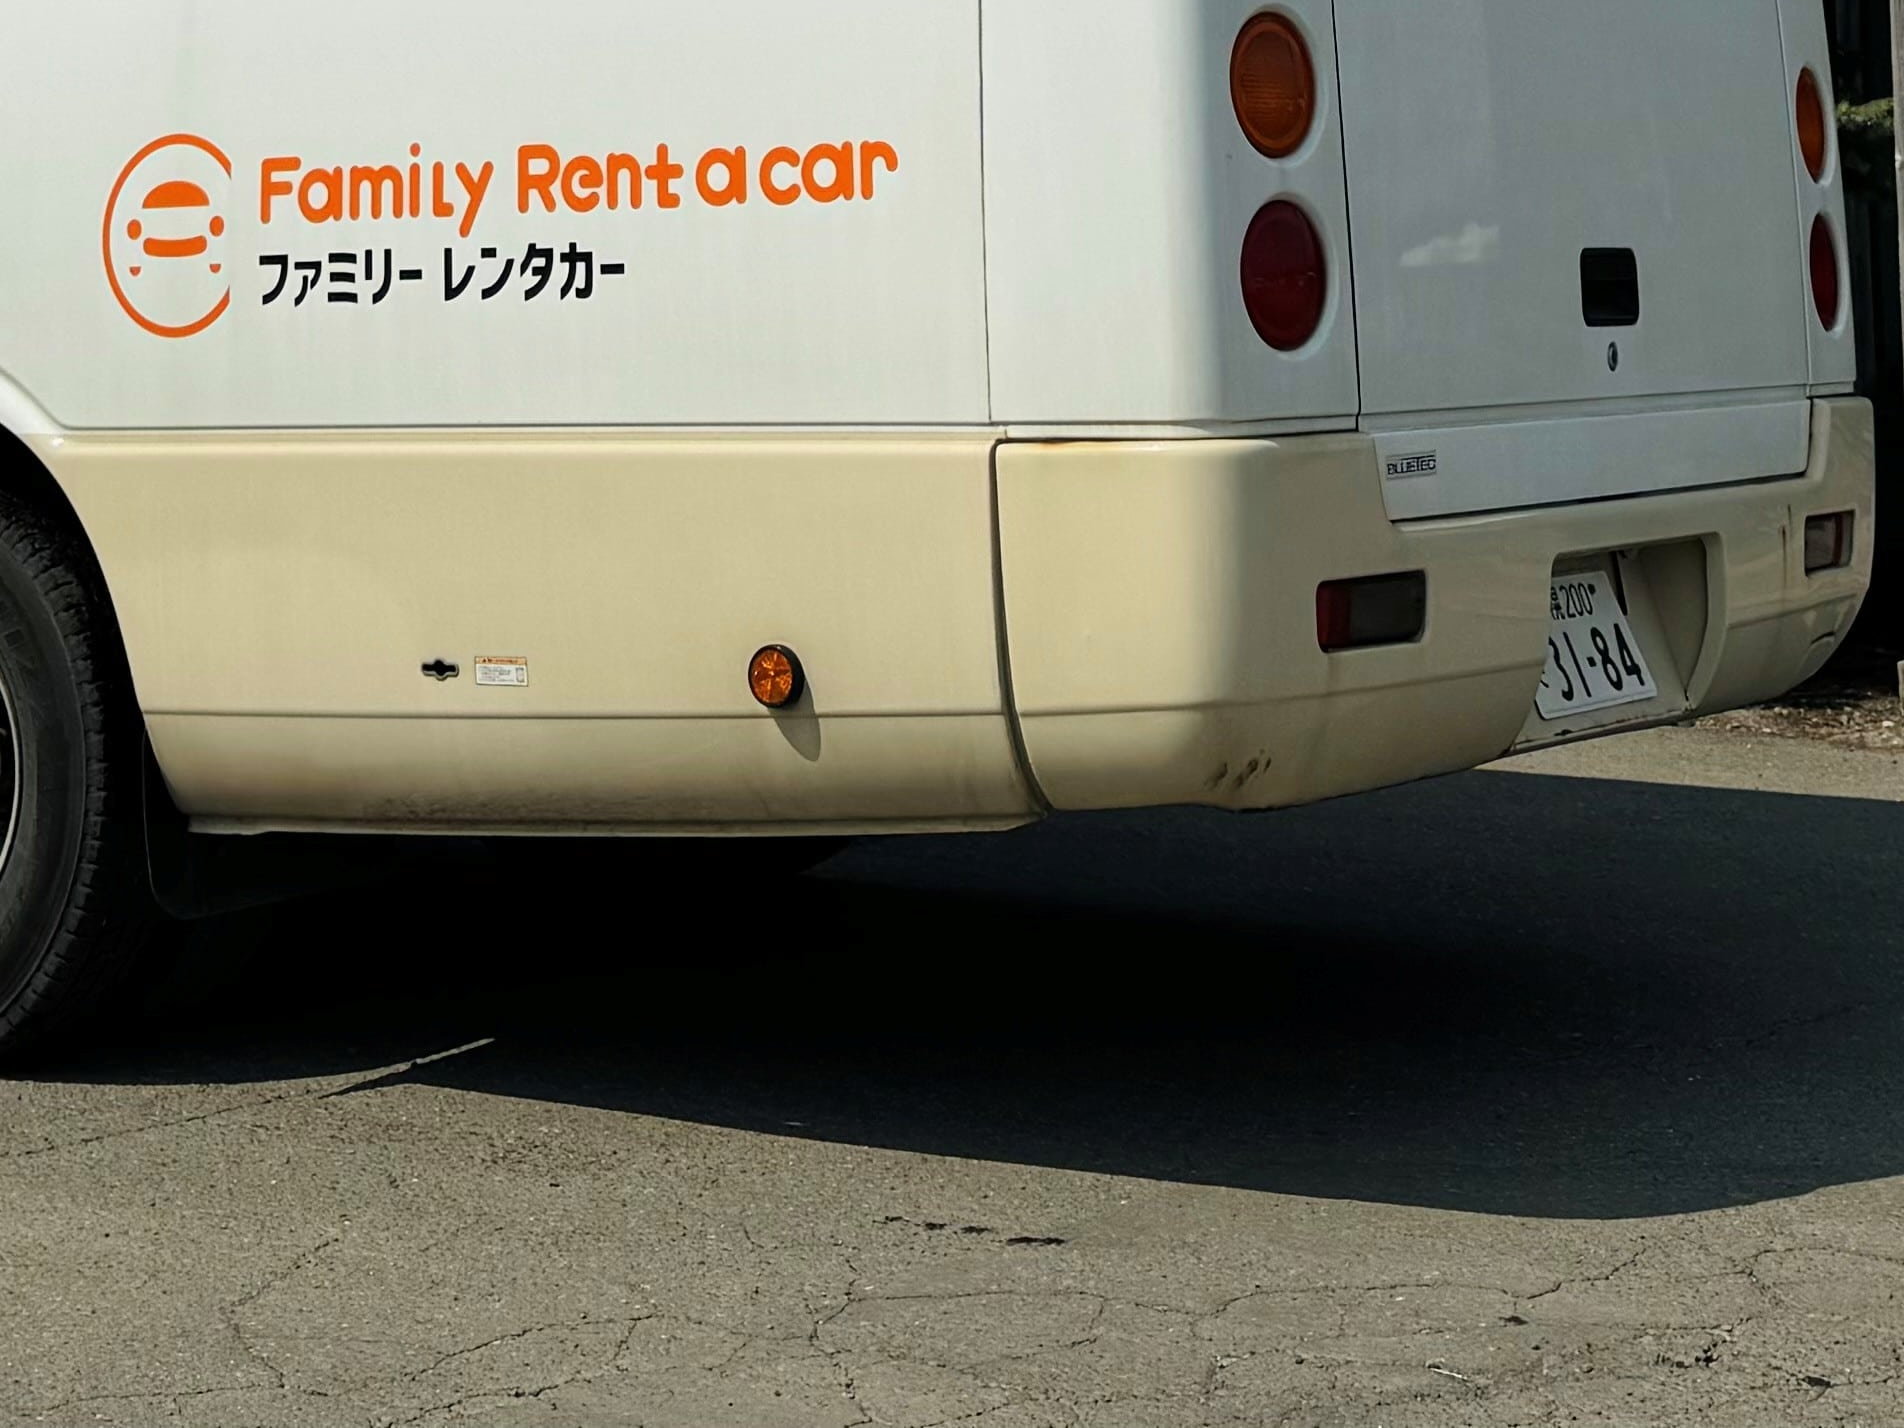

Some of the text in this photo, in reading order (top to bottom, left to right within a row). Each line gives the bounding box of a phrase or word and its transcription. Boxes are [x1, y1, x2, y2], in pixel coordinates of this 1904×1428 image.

[260, 143, 495, 239] Family
[258, 241, 625, 308] ファミリー レンタカー
[1559, 582, 1593, 618] 200
[1548, 622, 1645, 701] 31-84
